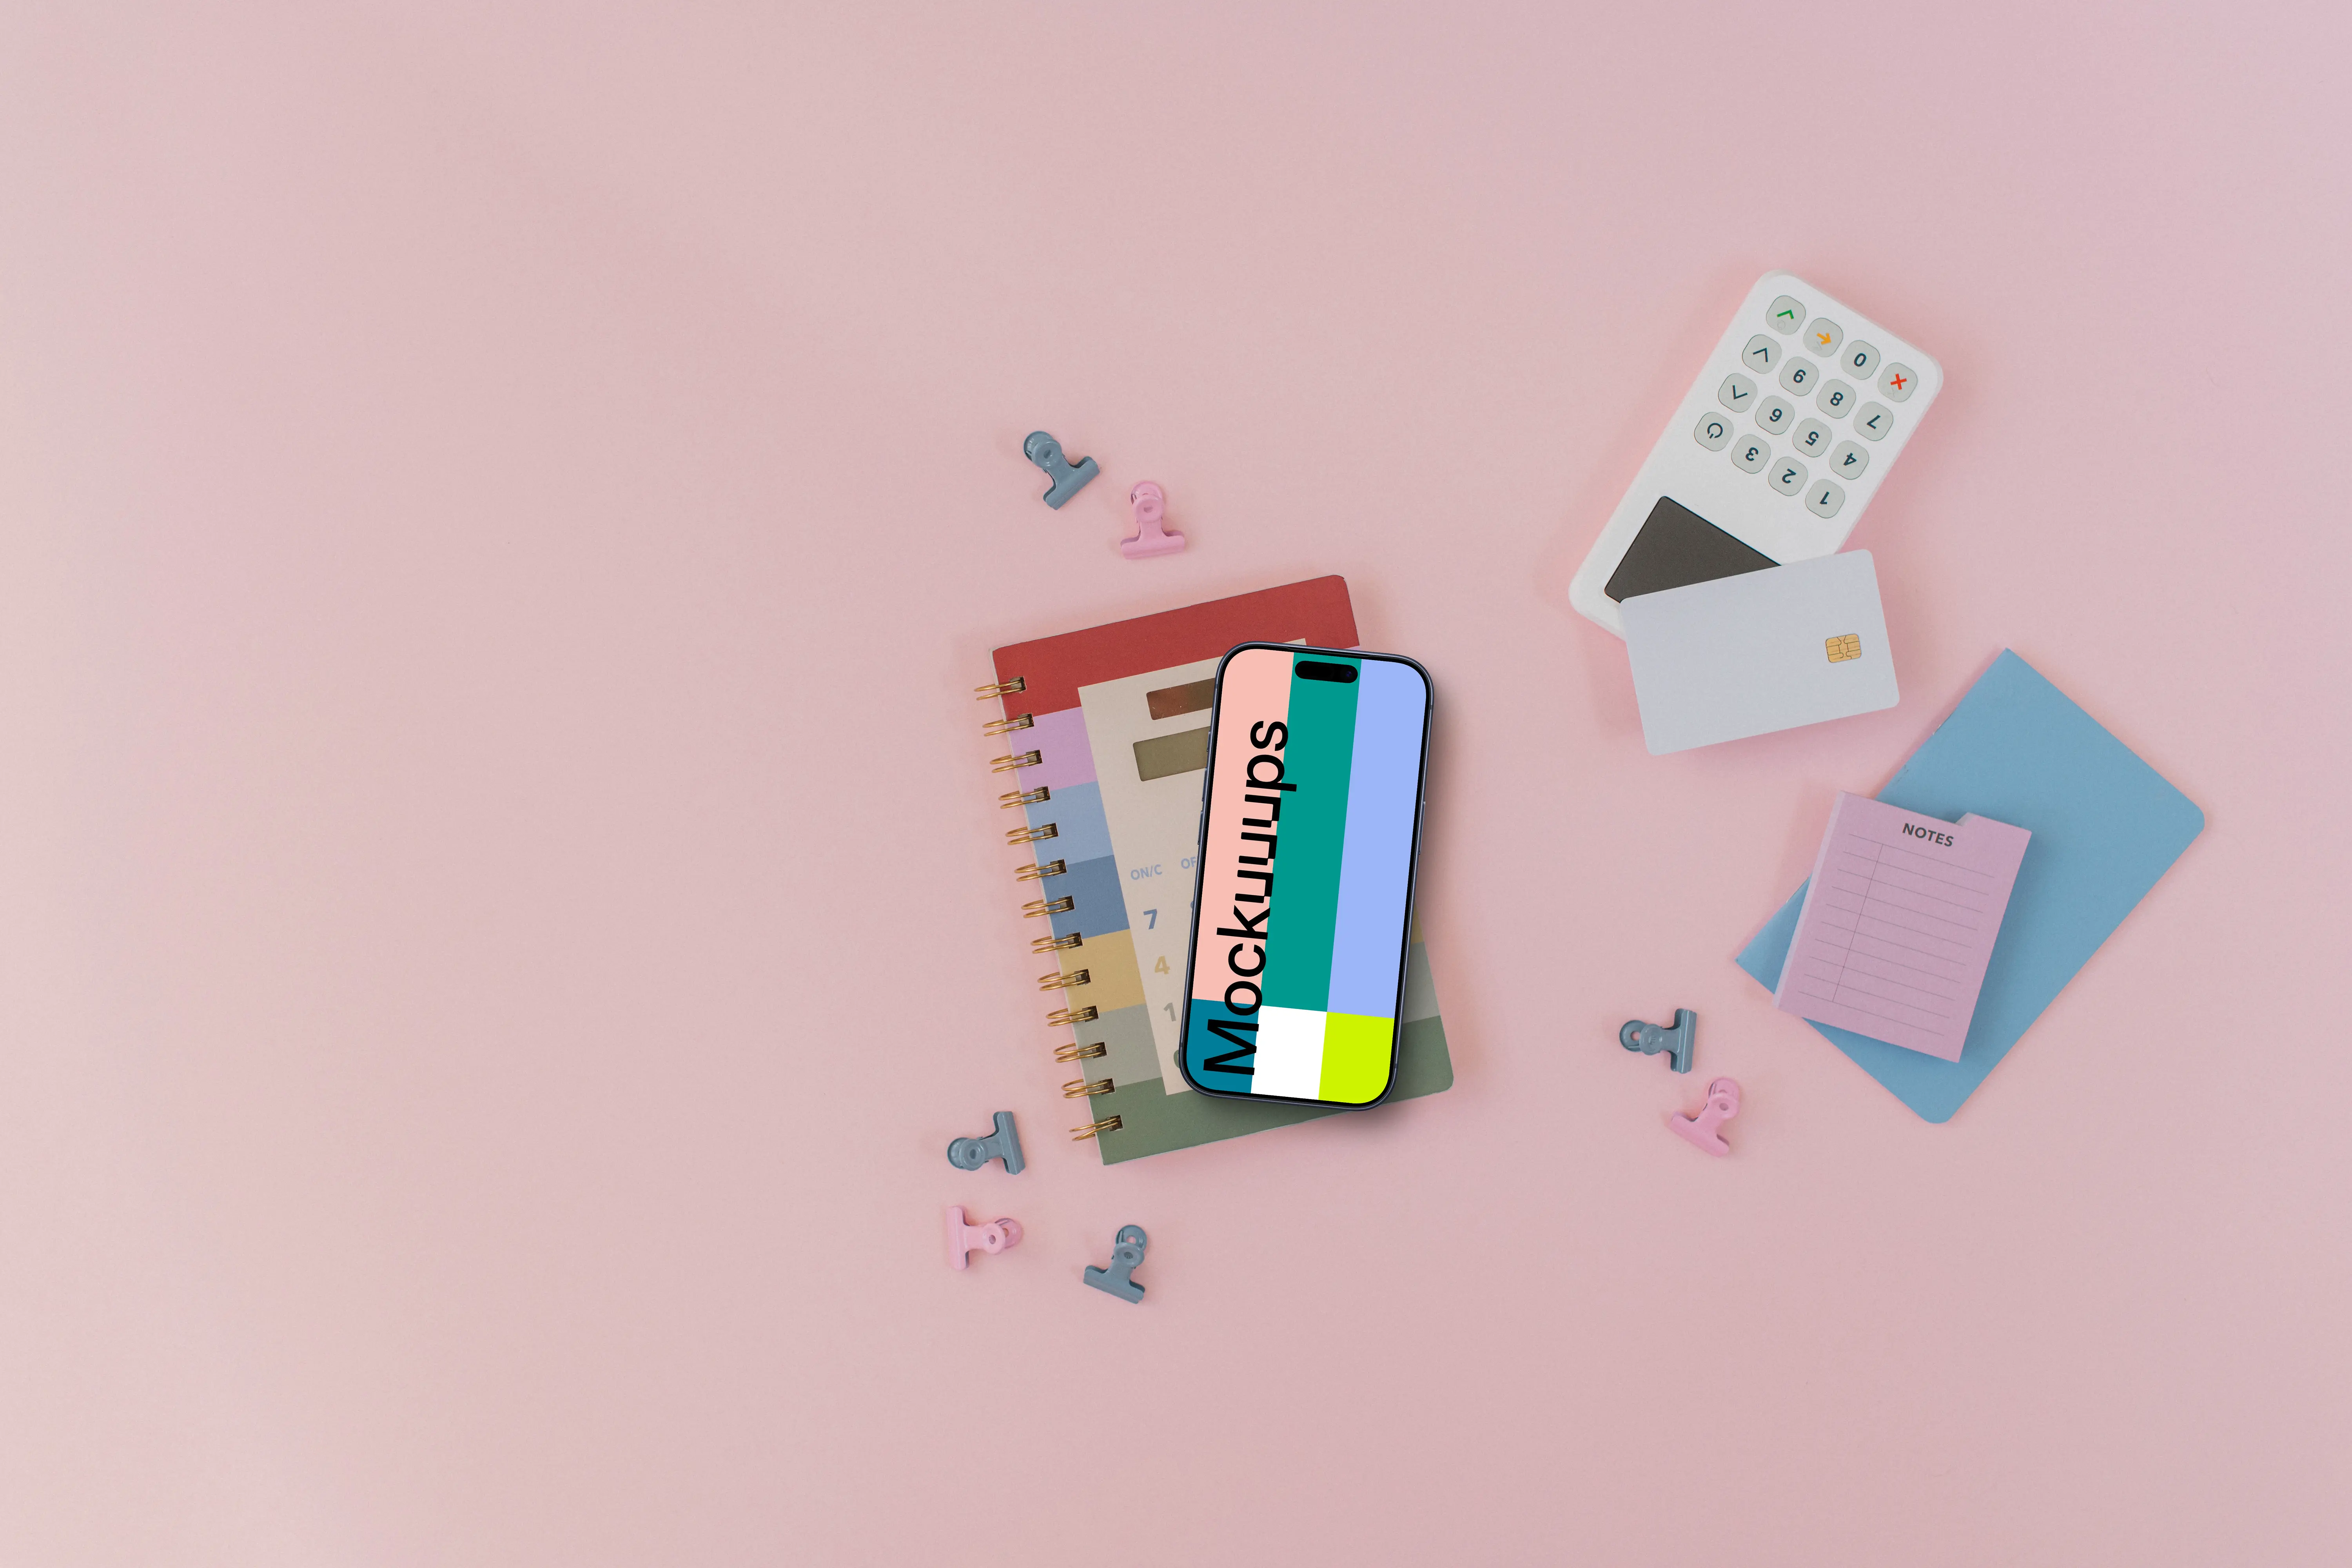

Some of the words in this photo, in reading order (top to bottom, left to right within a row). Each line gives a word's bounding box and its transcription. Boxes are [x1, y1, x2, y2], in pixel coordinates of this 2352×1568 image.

[1854, 353, 1867, 367] 0
[1793, 369, 1806, 383] 9
[1830, 392, 1844, 406] 8
[1769, 408, 1782, 422] 6
[1866, 415, 1881, 430] 7
[1805, 431, 1819, 446] 5
[1745, 447, 1759, 461] 3
[1843, 452, 1857, 466] 4
[1782, 468, 1797, 484] 2
[1819, 491, 1830, 505] 1
[1902, 823, 1954, 847] NOTES
[1181, 856, 1198, 869] OF
[1131, 864, 1163, 880] ON/C
[1203, 720, 1297, 1075] Mockuuups
[1143, 909, 1158, 929] 7
[1154, 956, 1170, 975] 4
[1163, 1002, 1176, 1022] 1
